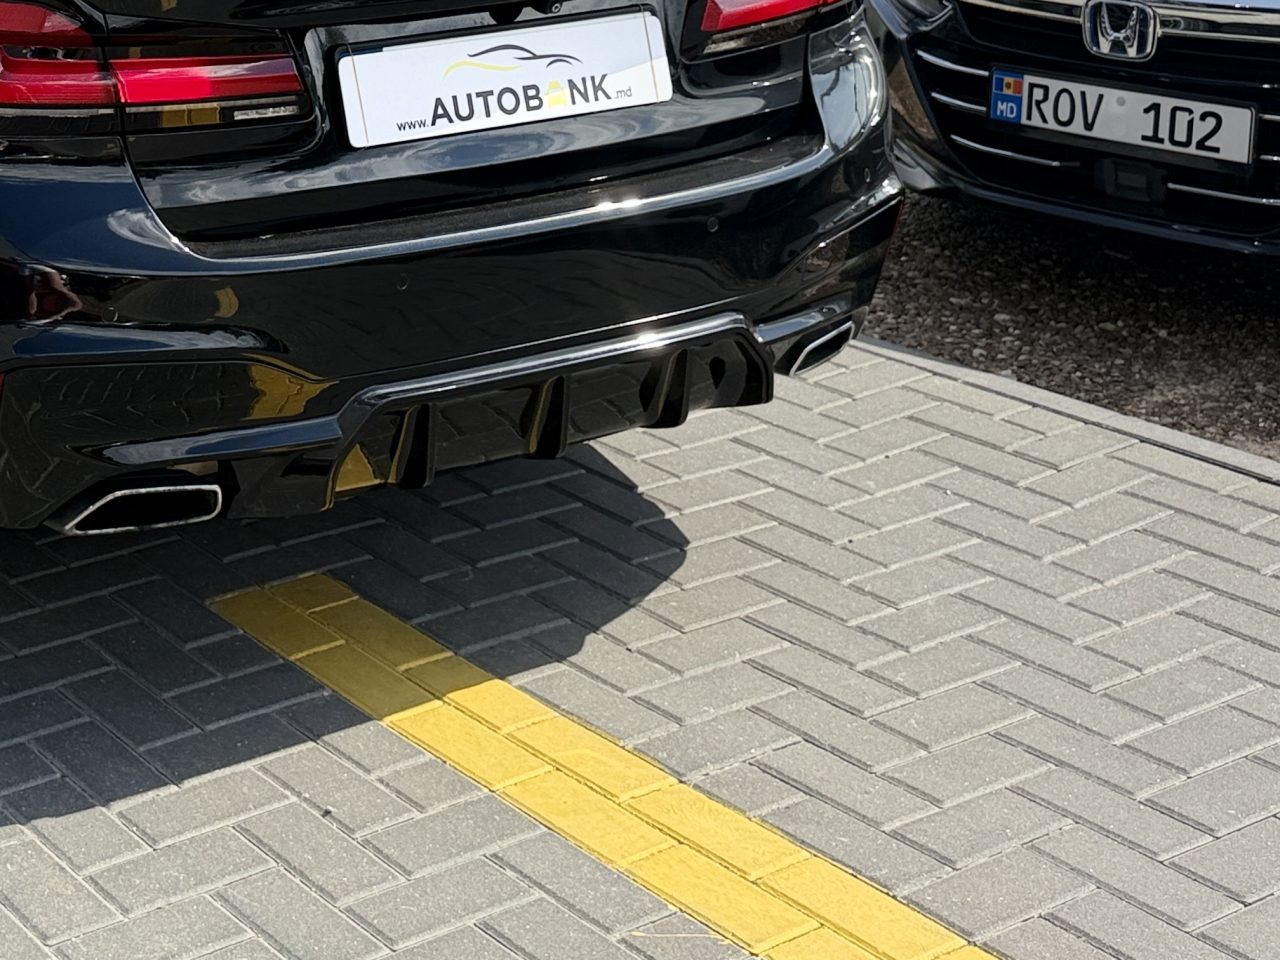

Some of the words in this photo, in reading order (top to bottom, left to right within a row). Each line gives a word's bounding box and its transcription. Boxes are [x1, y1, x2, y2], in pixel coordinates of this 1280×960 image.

[996, 100, 1017, 119] MD
[1025, 81, 1104, 132] ROV
[1141, 102, 1223, 154] 102
